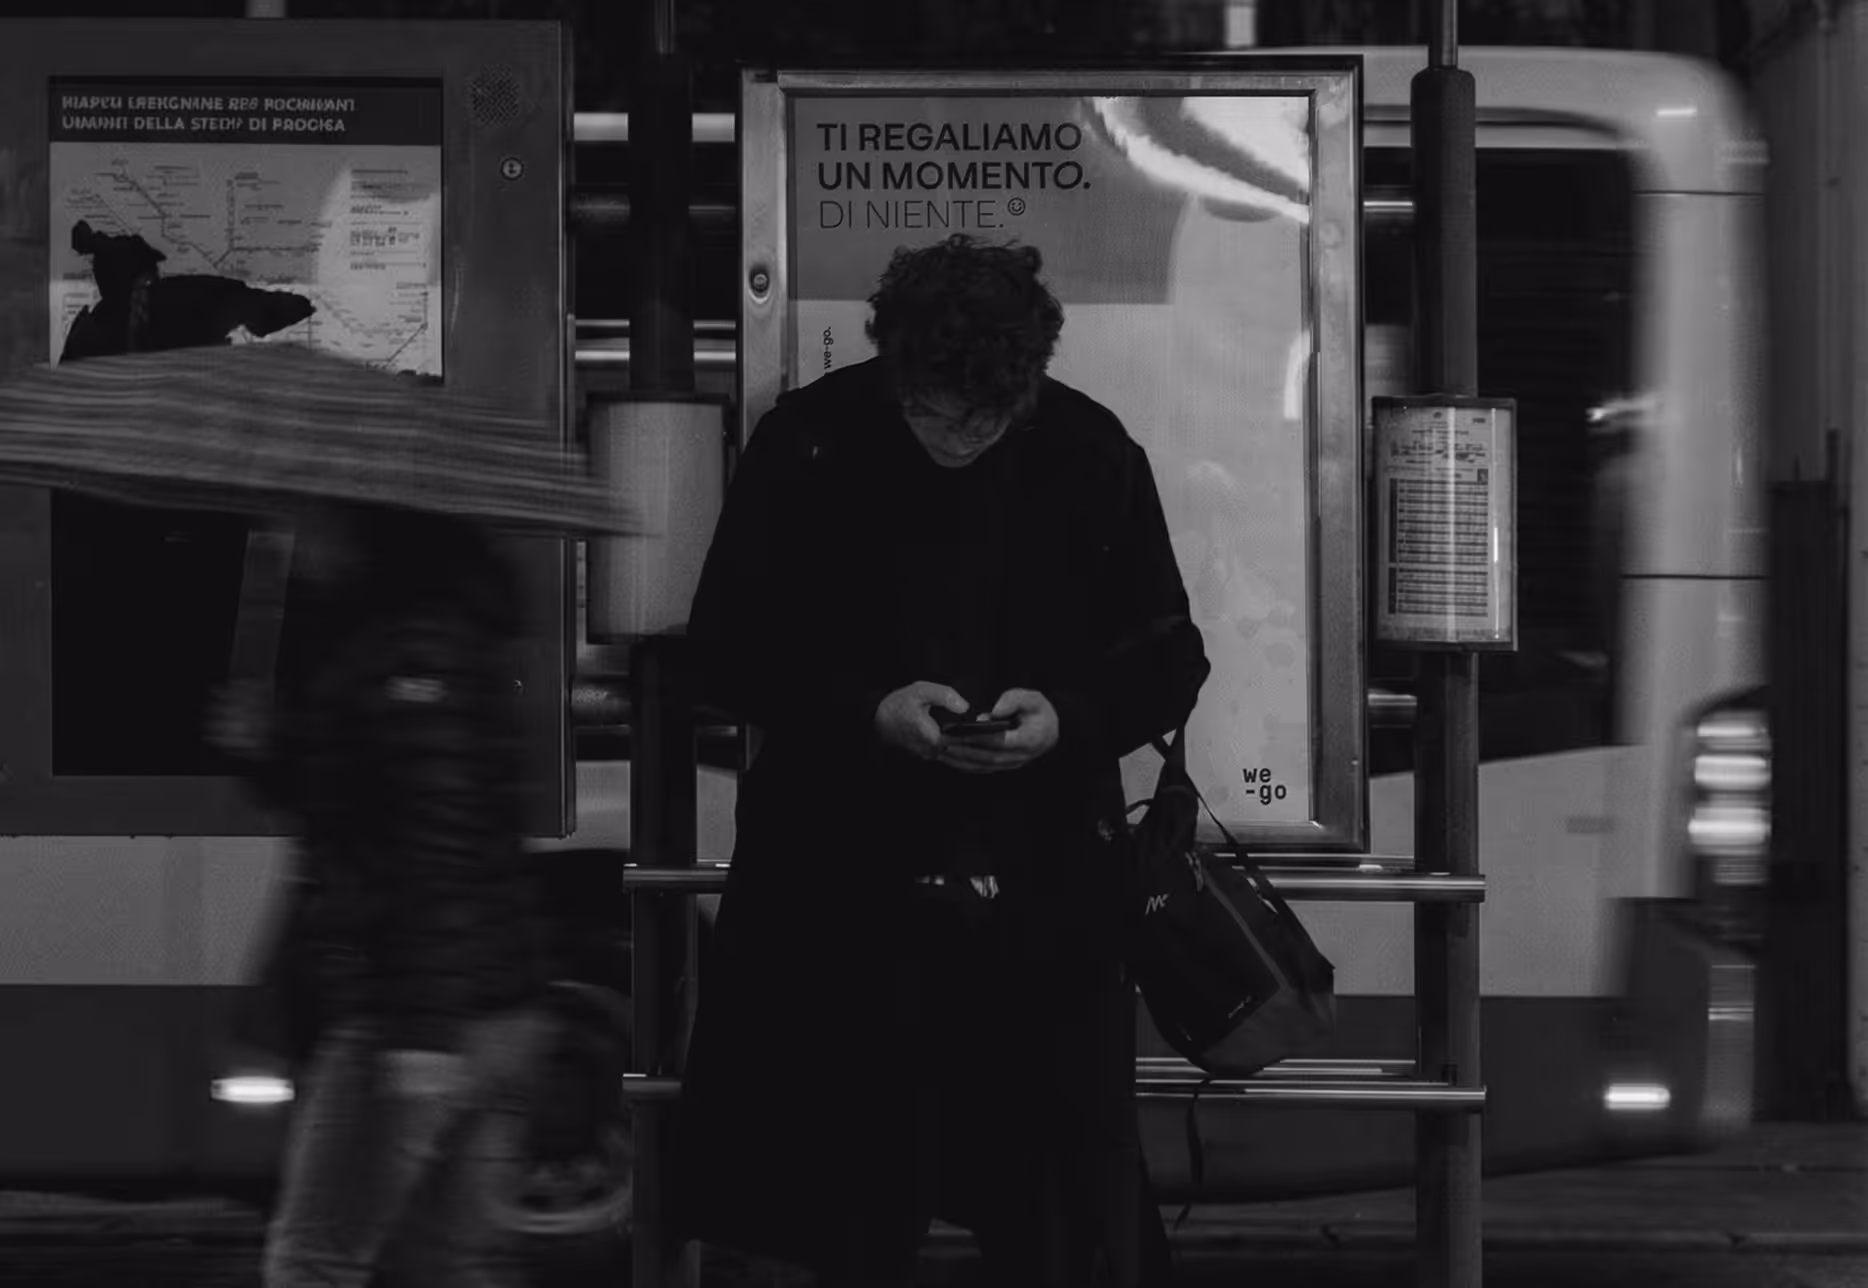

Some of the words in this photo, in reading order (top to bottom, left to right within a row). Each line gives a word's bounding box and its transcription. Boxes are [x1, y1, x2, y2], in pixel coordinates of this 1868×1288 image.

[134, 116, 185, 130] DELLA
[249, 117, 267, 131] DI
[816, 123, 847, 151] TI
[858, 122, 1082, 152] REGALIAMO
[818, 161, 870, 190] UN
[882, 161, 1091, 190] MOMENTO.
[820, 200, 852, 229] DI
[867, 200, 1004, 229] NIENTE.
[1242, 767, 1271, 783] we
